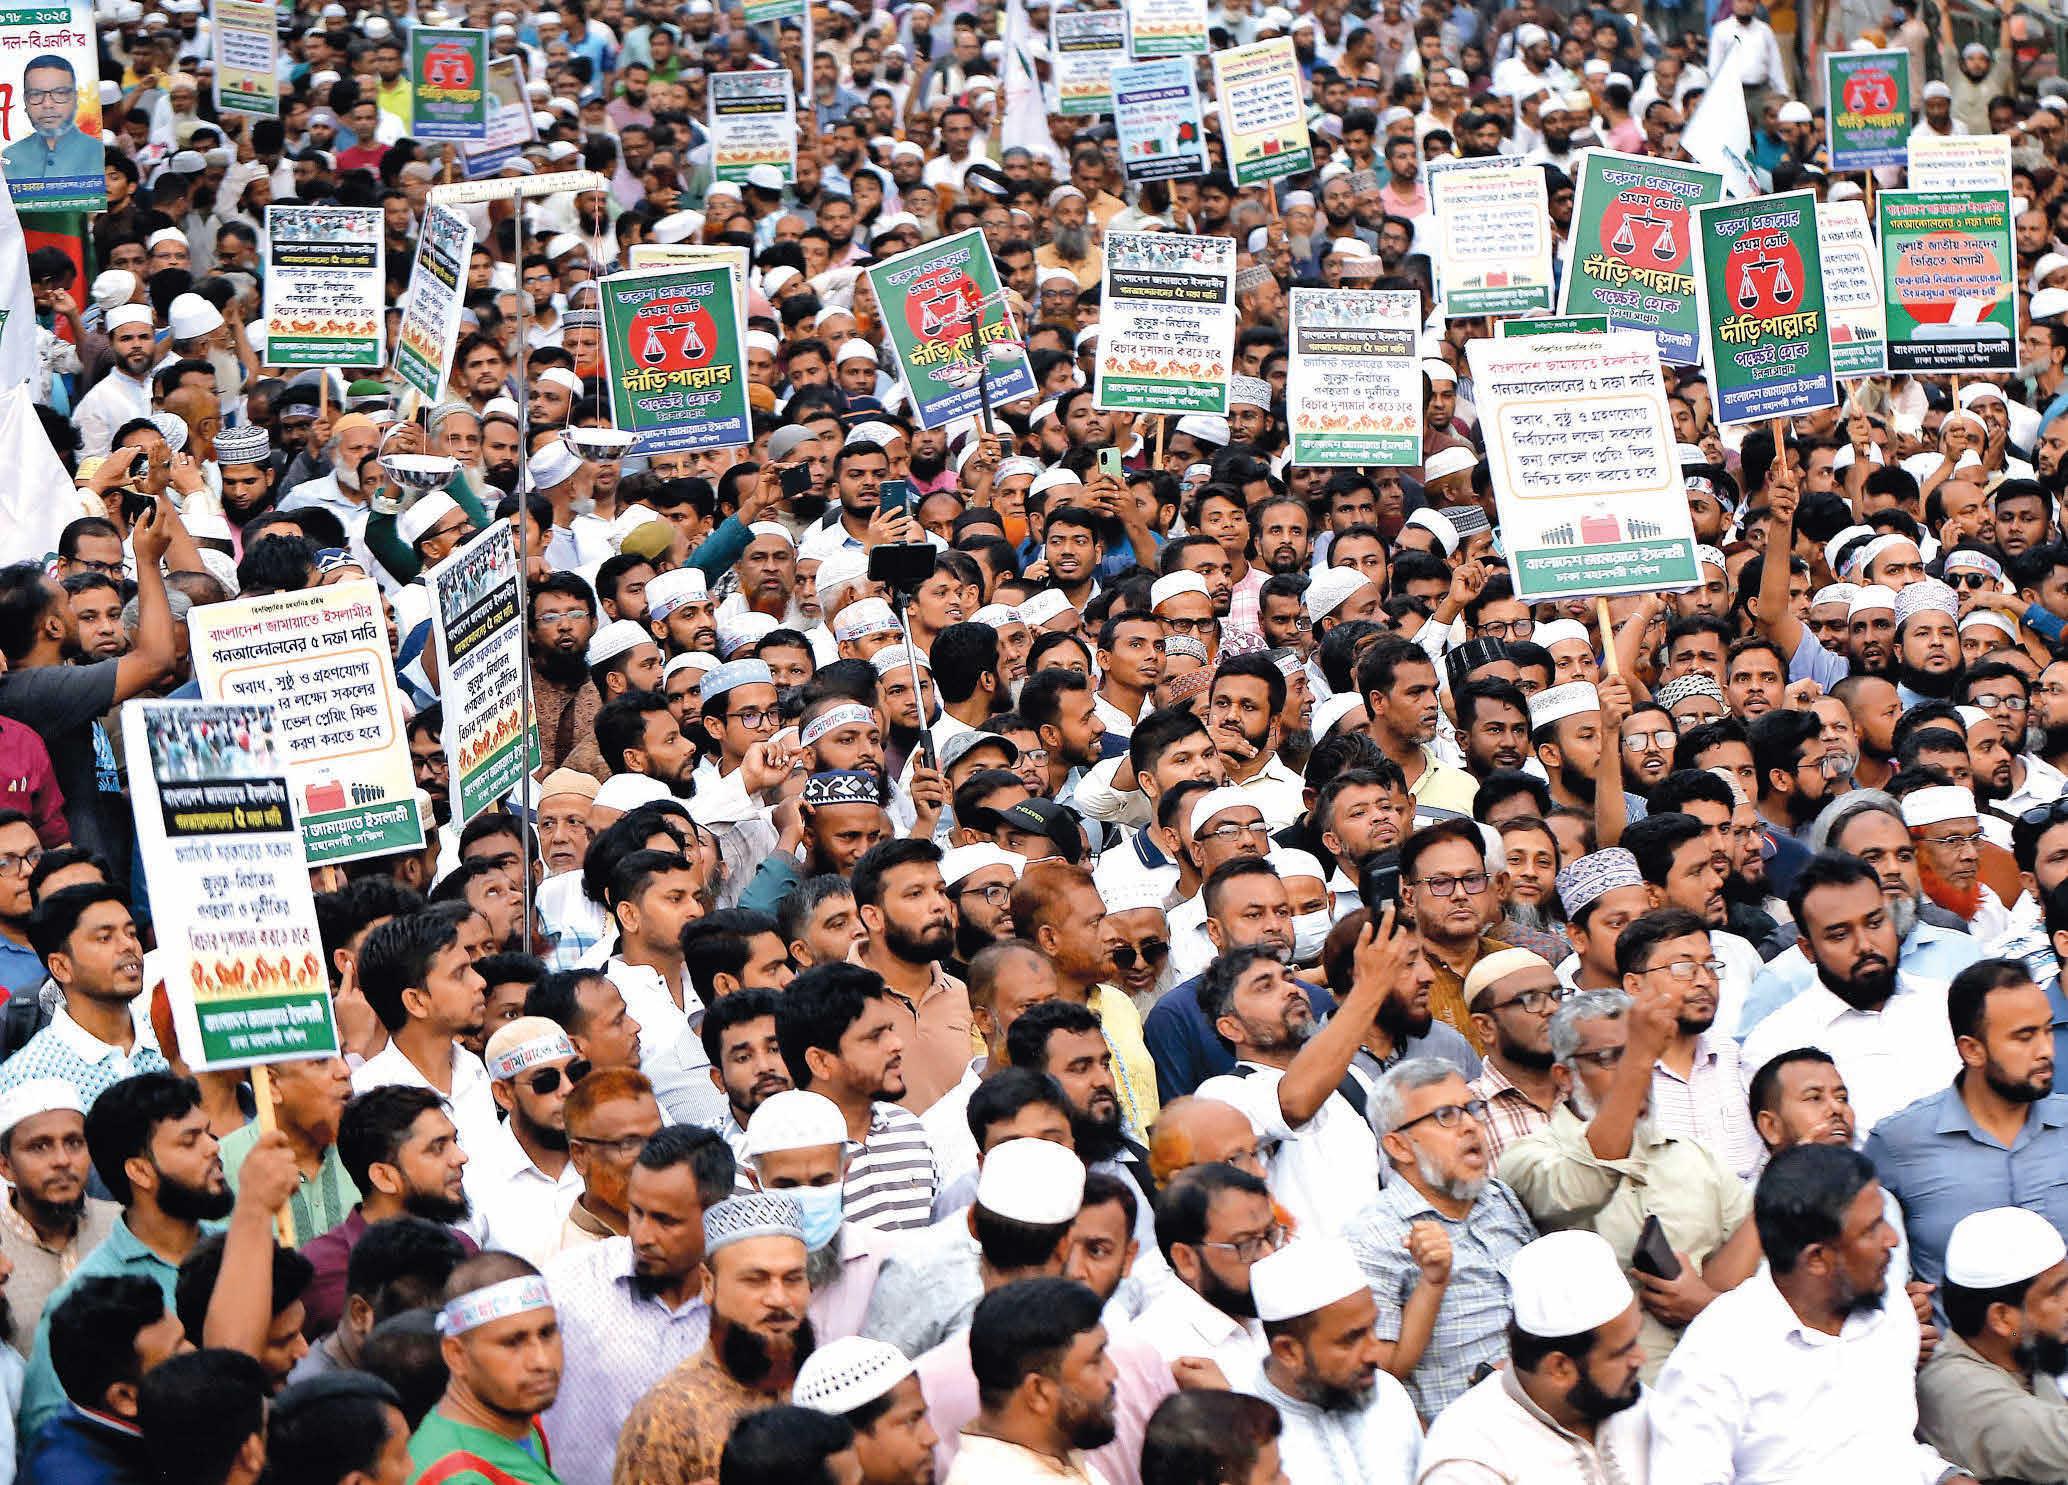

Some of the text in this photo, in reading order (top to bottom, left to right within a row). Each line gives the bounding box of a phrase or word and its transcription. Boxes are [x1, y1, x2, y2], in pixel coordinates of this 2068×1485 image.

[1602, 169, 1643, 187] তরুণ
[1645, 175, 1703, 198] প্রজন্মের
[1619, 191, 1684, 211] প্রথম ভোট
[1715, 210, 1801, 236] তরুণ প্রজন্মের
[1733, 231, 1789, 254] প্রথম ভোট
[617, 282, 714, 304] তরুণ প্রজন্মের
[909, 268, 963, 296] প্রথম ভোট
[639, 299, 700, 318] প্রথম ভোট
[1893, 340, 2009, 355] বাংলাদেশ জামায়াতে ইসলামী
[1524, 542, 1686, 571] বাংলাদেশ জামায়াতে ইসলামী
[208, 602, 372, 643] বাংলাদেশ জামায়াতে ইসলামীর
[212, 621, 377, 664] গনআন্দোলনের ৫ দফা দাবি
[300, 673, 310, 684] ও
[312, 662, 370, 684] গ্রহণযোগ্য
[332, 683, 376, 701] সকলের
[488, 686, 493, 697] ও
[320, 731, 355, 746] করতে
[359, 725, 381, 739] হবে
[309, 805, 409, 837] জামায়াতে ইসলামী
